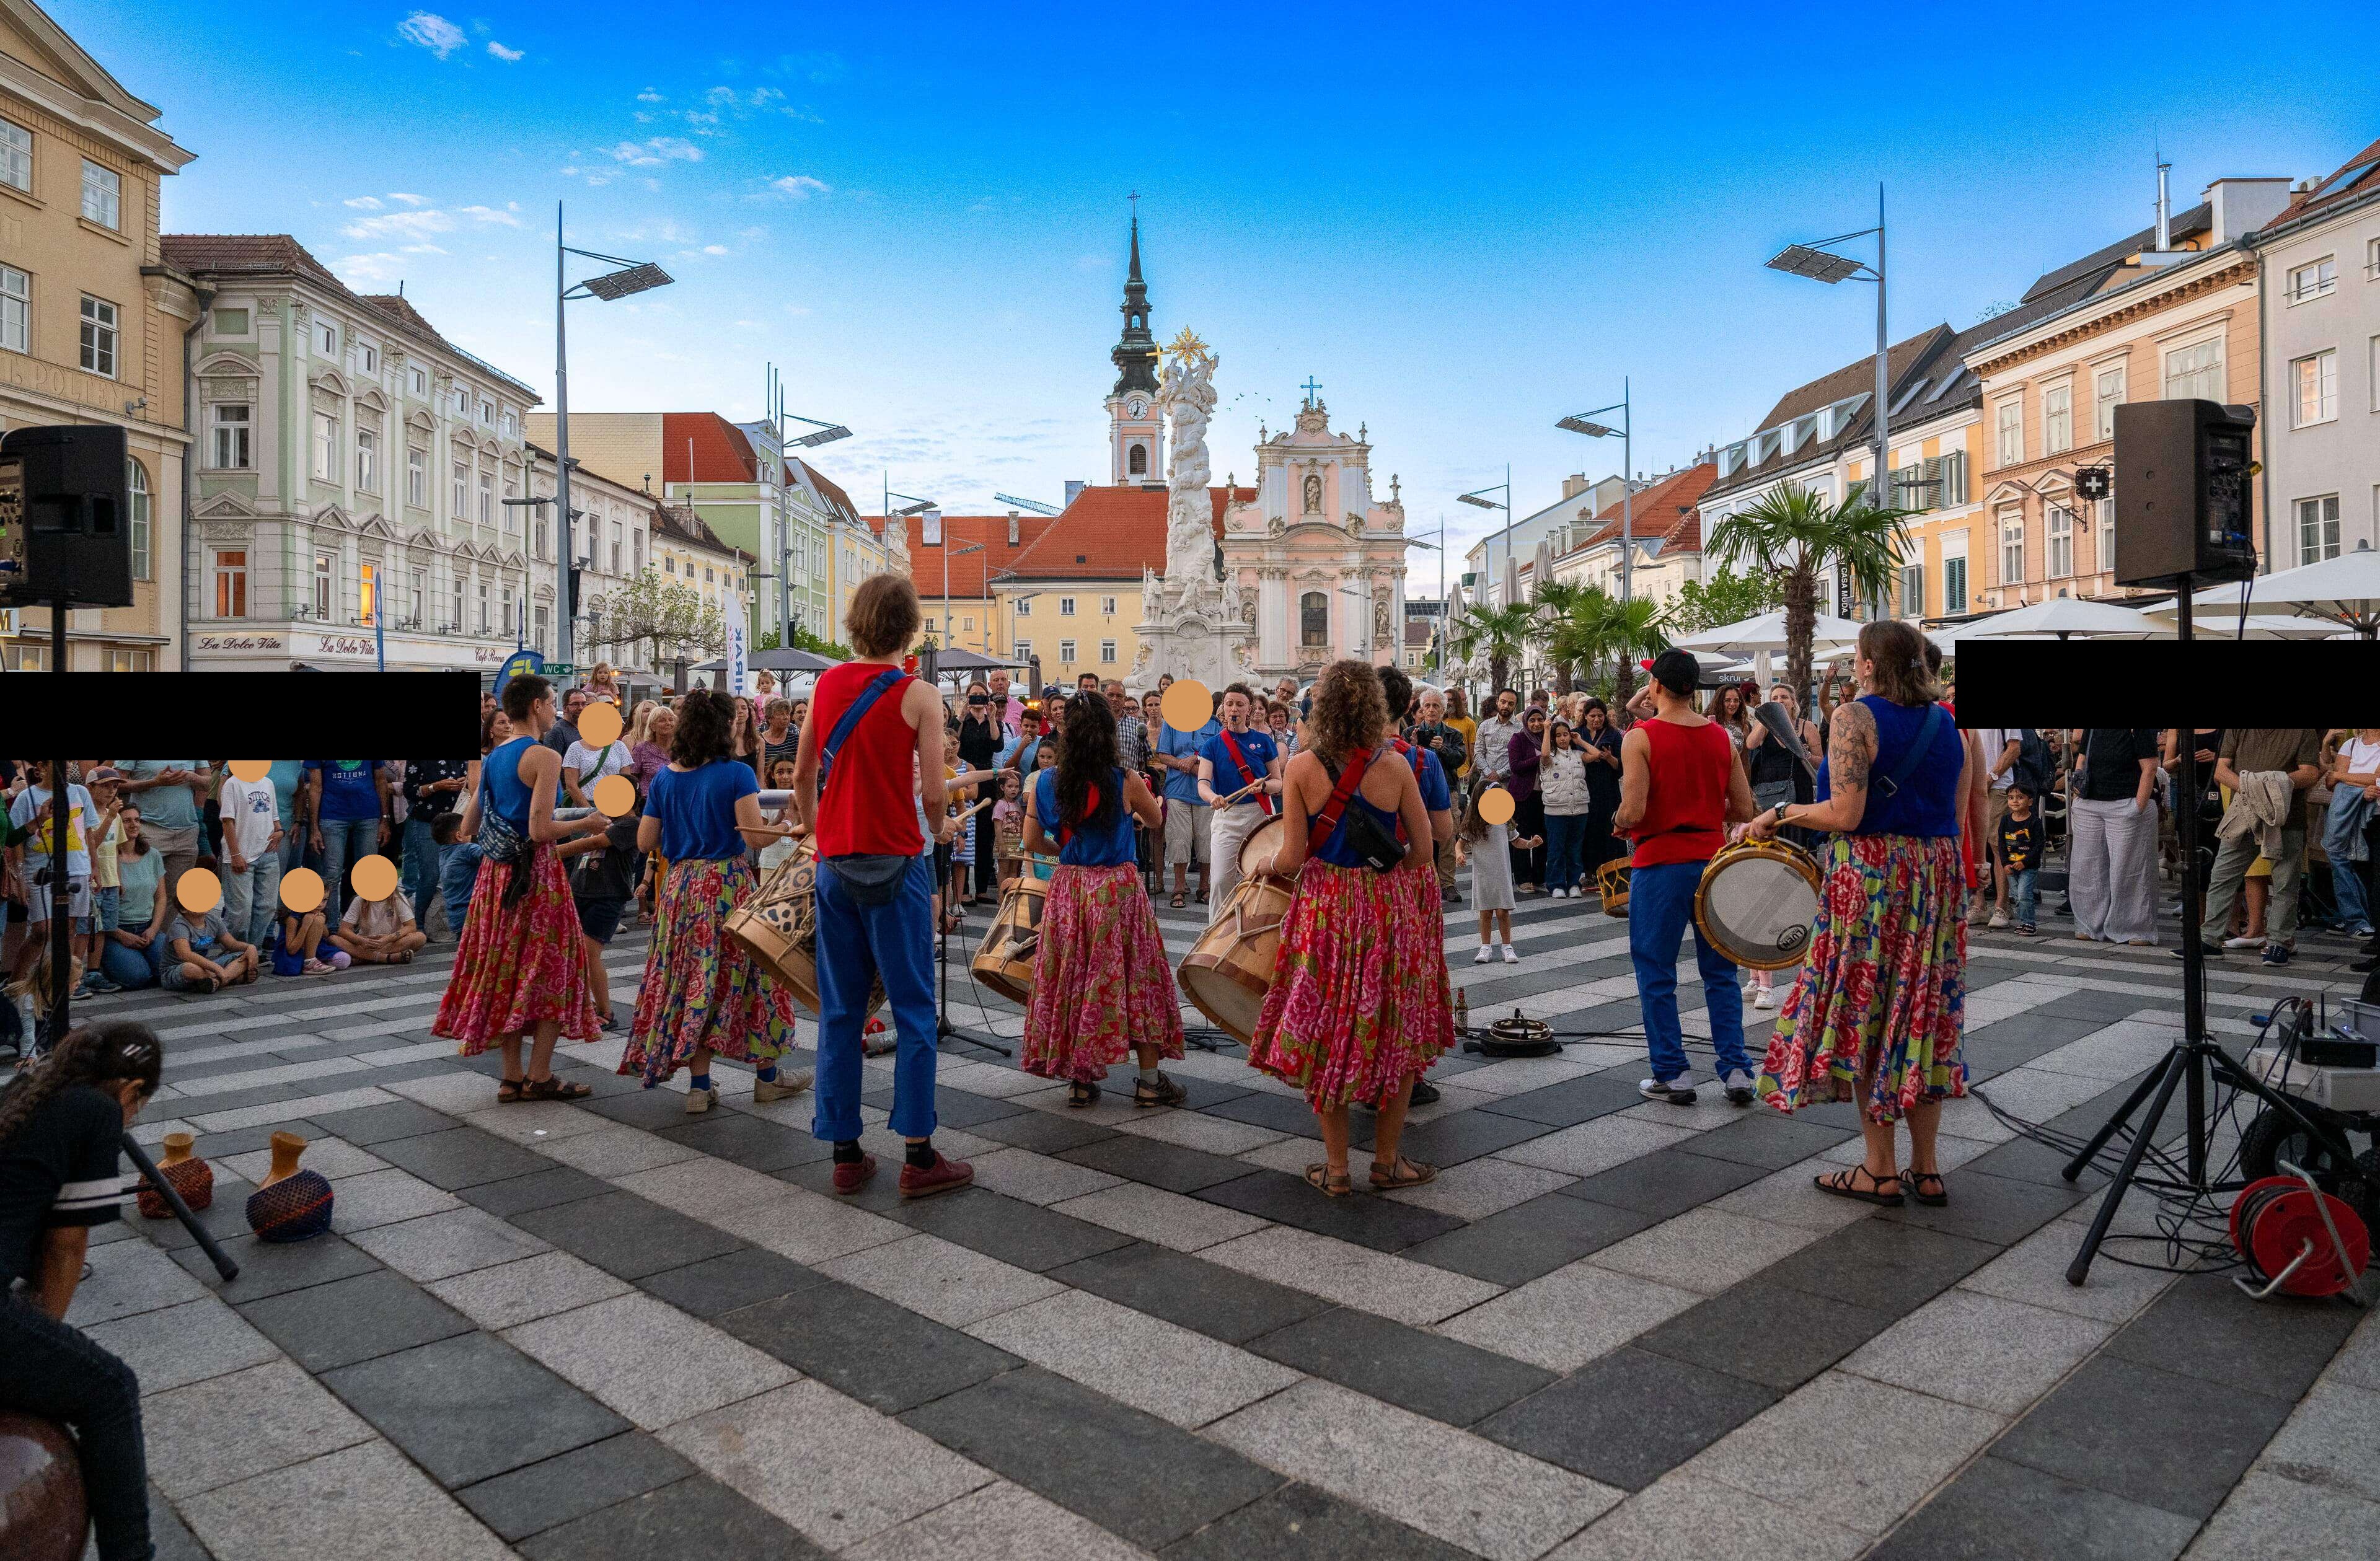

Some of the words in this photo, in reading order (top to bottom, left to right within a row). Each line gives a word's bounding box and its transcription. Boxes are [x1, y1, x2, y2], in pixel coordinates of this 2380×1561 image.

[198, 637, 220, 650] La
[222, 637, 255, 650] Dolce
[257, 637, 282, 650] Vita
[319, 636, 334, 653] La
[337, 638, 358, 654] Dolce
[359, 640, 375, 656] Vita
[544, 665, 560, 674] WC
